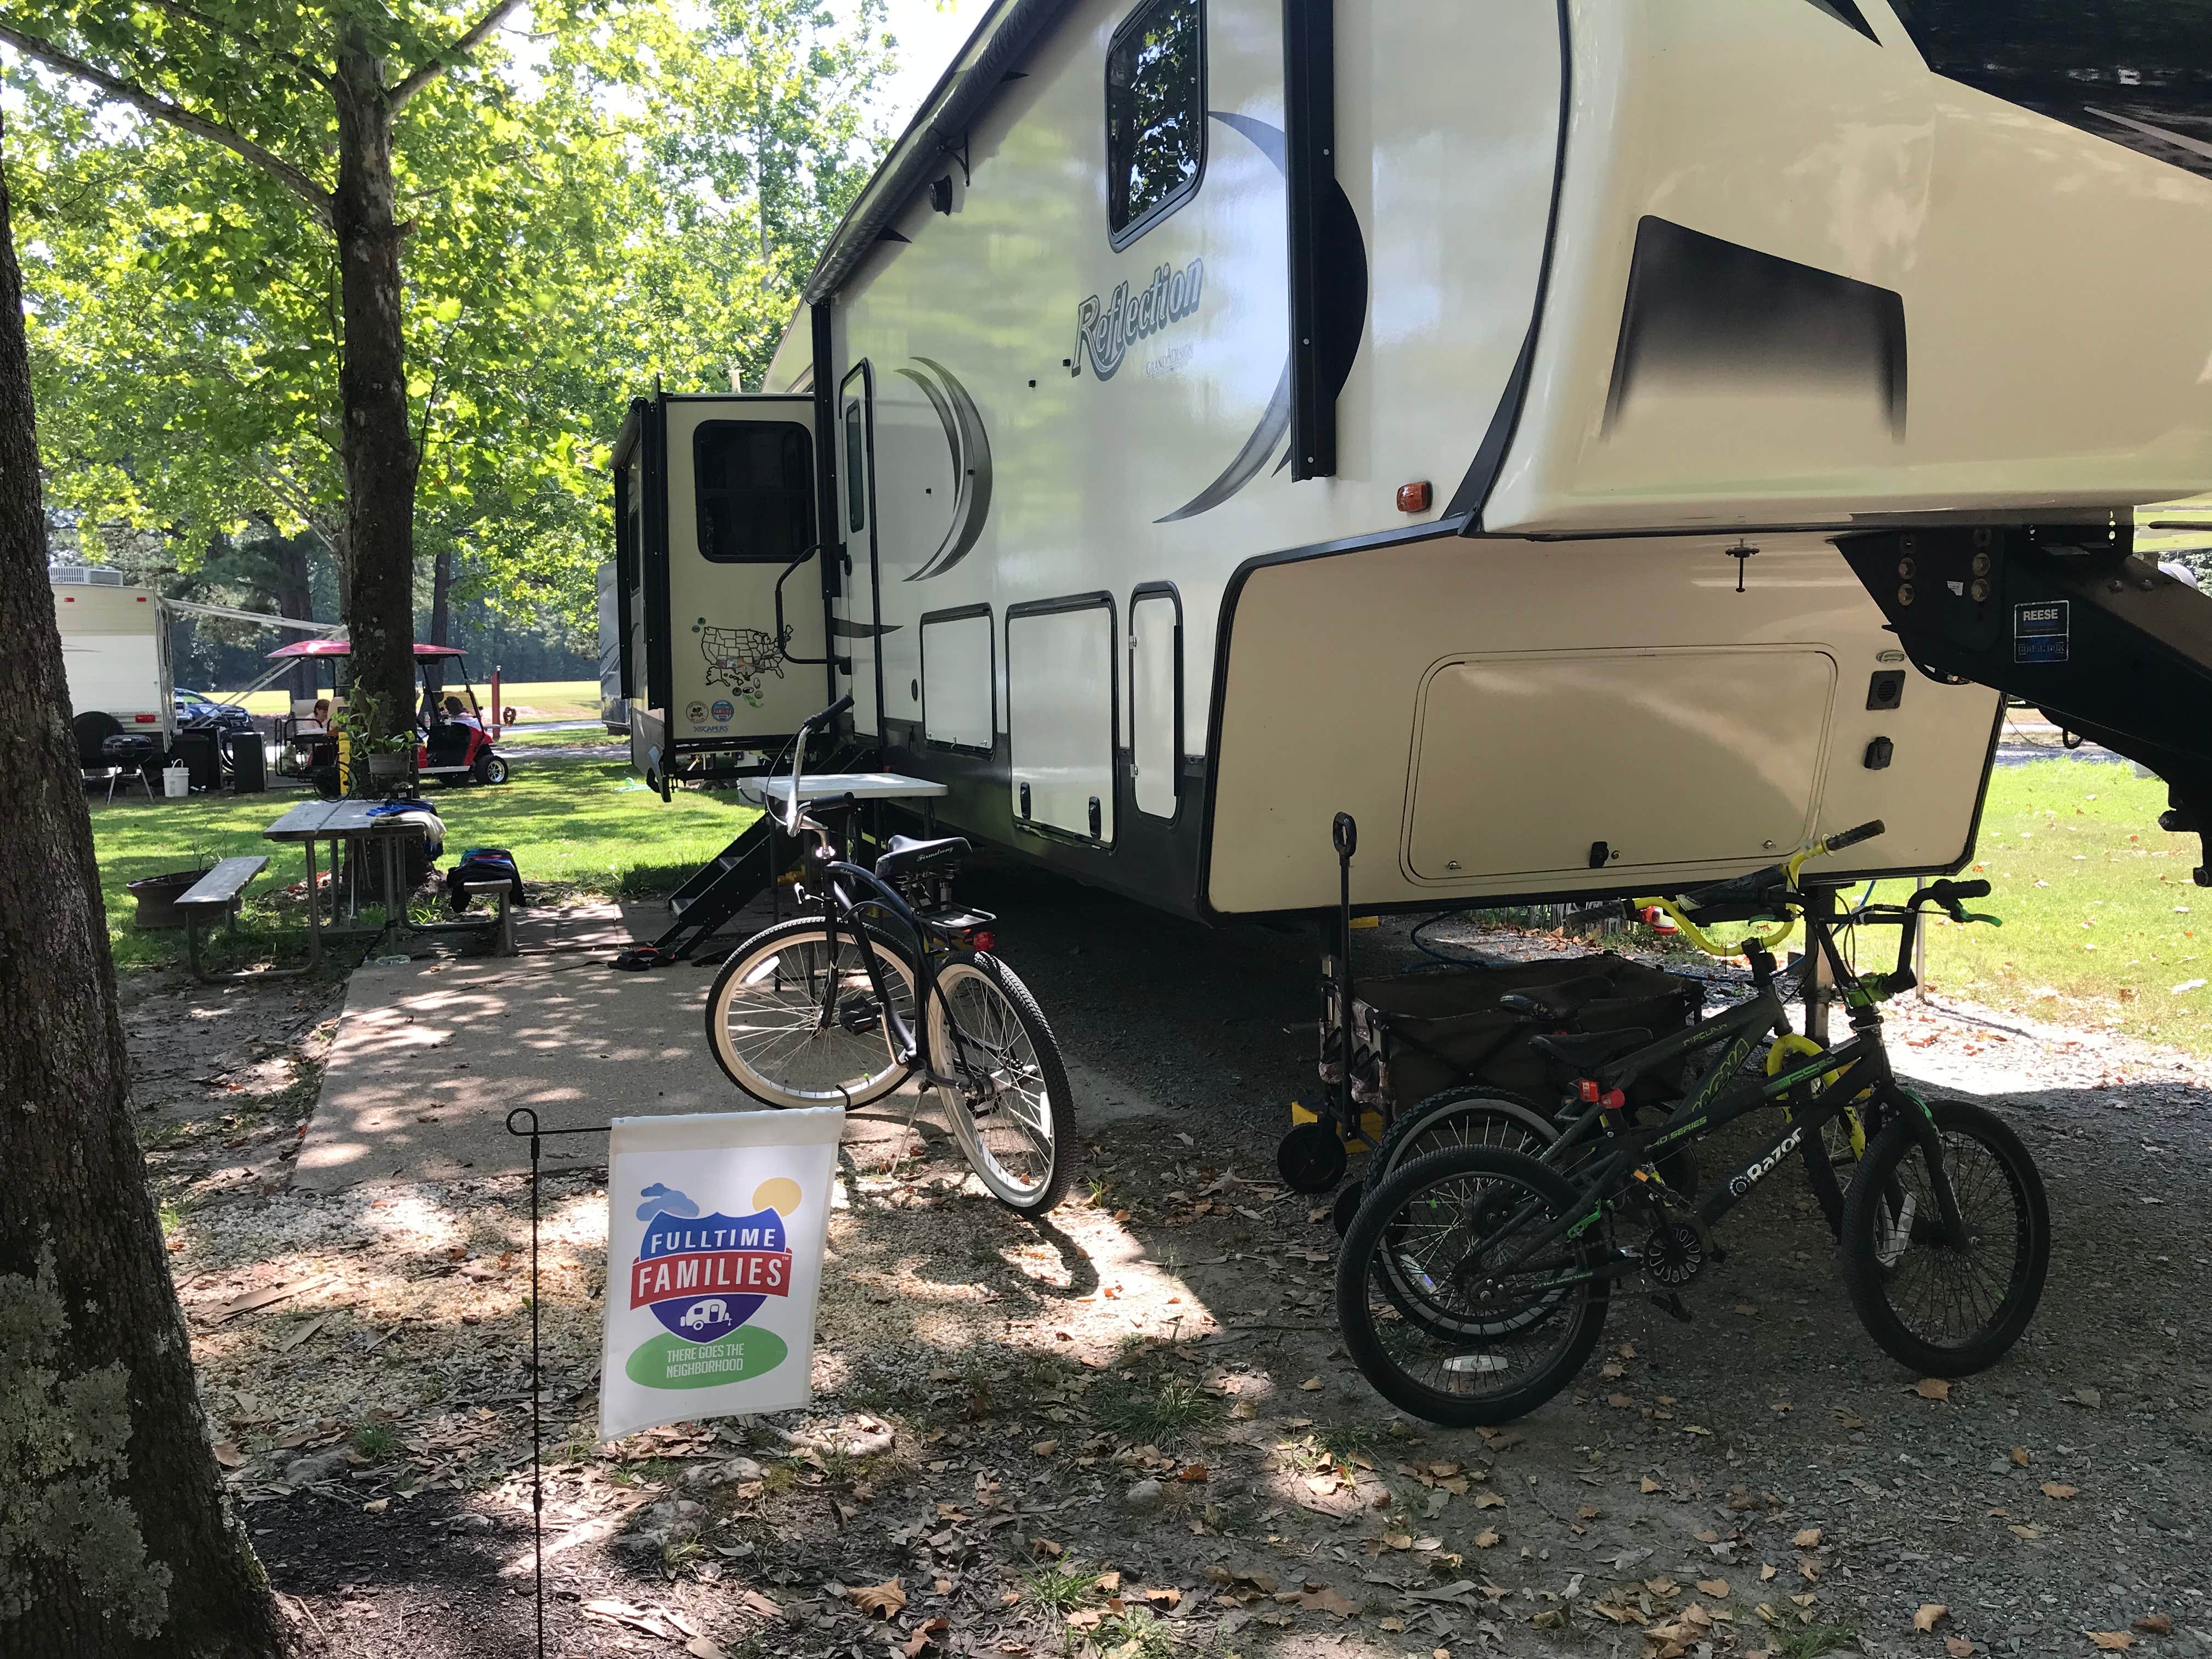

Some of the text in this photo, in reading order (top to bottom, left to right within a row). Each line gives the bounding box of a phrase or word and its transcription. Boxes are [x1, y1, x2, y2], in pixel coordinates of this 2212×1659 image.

[1071, 257, 1204, 382] Reflection
[2023, 608, 2059, 621] REESE
[916, 847, 953, 862] Firmstrong
[1683, 1023, 1728, 1047] RIPCLAW
[1670, 1115, 1708, 1139] SERIES
[1747, 1127, 1802, 1183] Razor
[651, 1228, 776, 1254] FULLTIME
[639, 1257, 782, 1299] FAMILIES
[667, 1343, 745, 1363] THERE GOES THE
[667, 1358, 743, 1379] NEIGHBORHOOD
